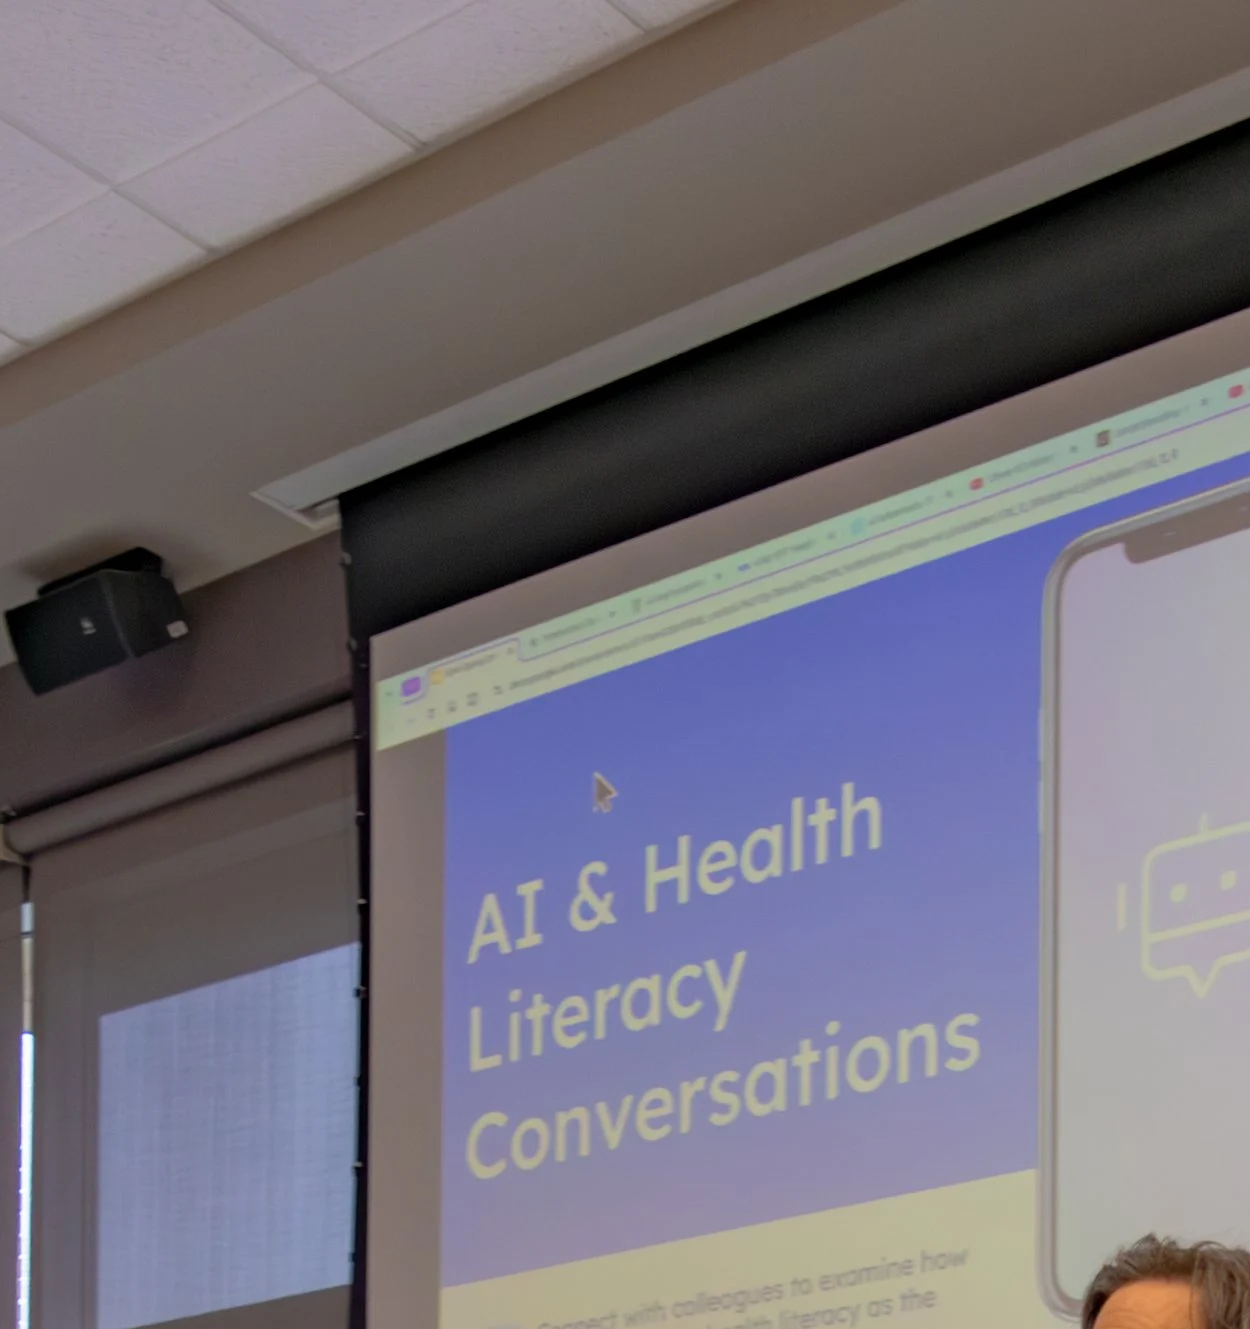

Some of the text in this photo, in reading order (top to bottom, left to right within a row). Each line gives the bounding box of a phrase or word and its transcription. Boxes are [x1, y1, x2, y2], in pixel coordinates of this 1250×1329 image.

[467, 782, 882, 964] AI & Health
[469, 950, 747, 1072] Literacy
[465, 1013, 981, 1180] Conversations
[624, 1299, 667, 1328] with
[672, 1280, 784, 1313] colleagues
[790, 1276, 813, 1297] to
[818, 1257, 914, 1291] examine
[919, 1249, 969, 1273] how
[867, 1298, 894, 1318] as
[899, 1287, 937, 1312] the
